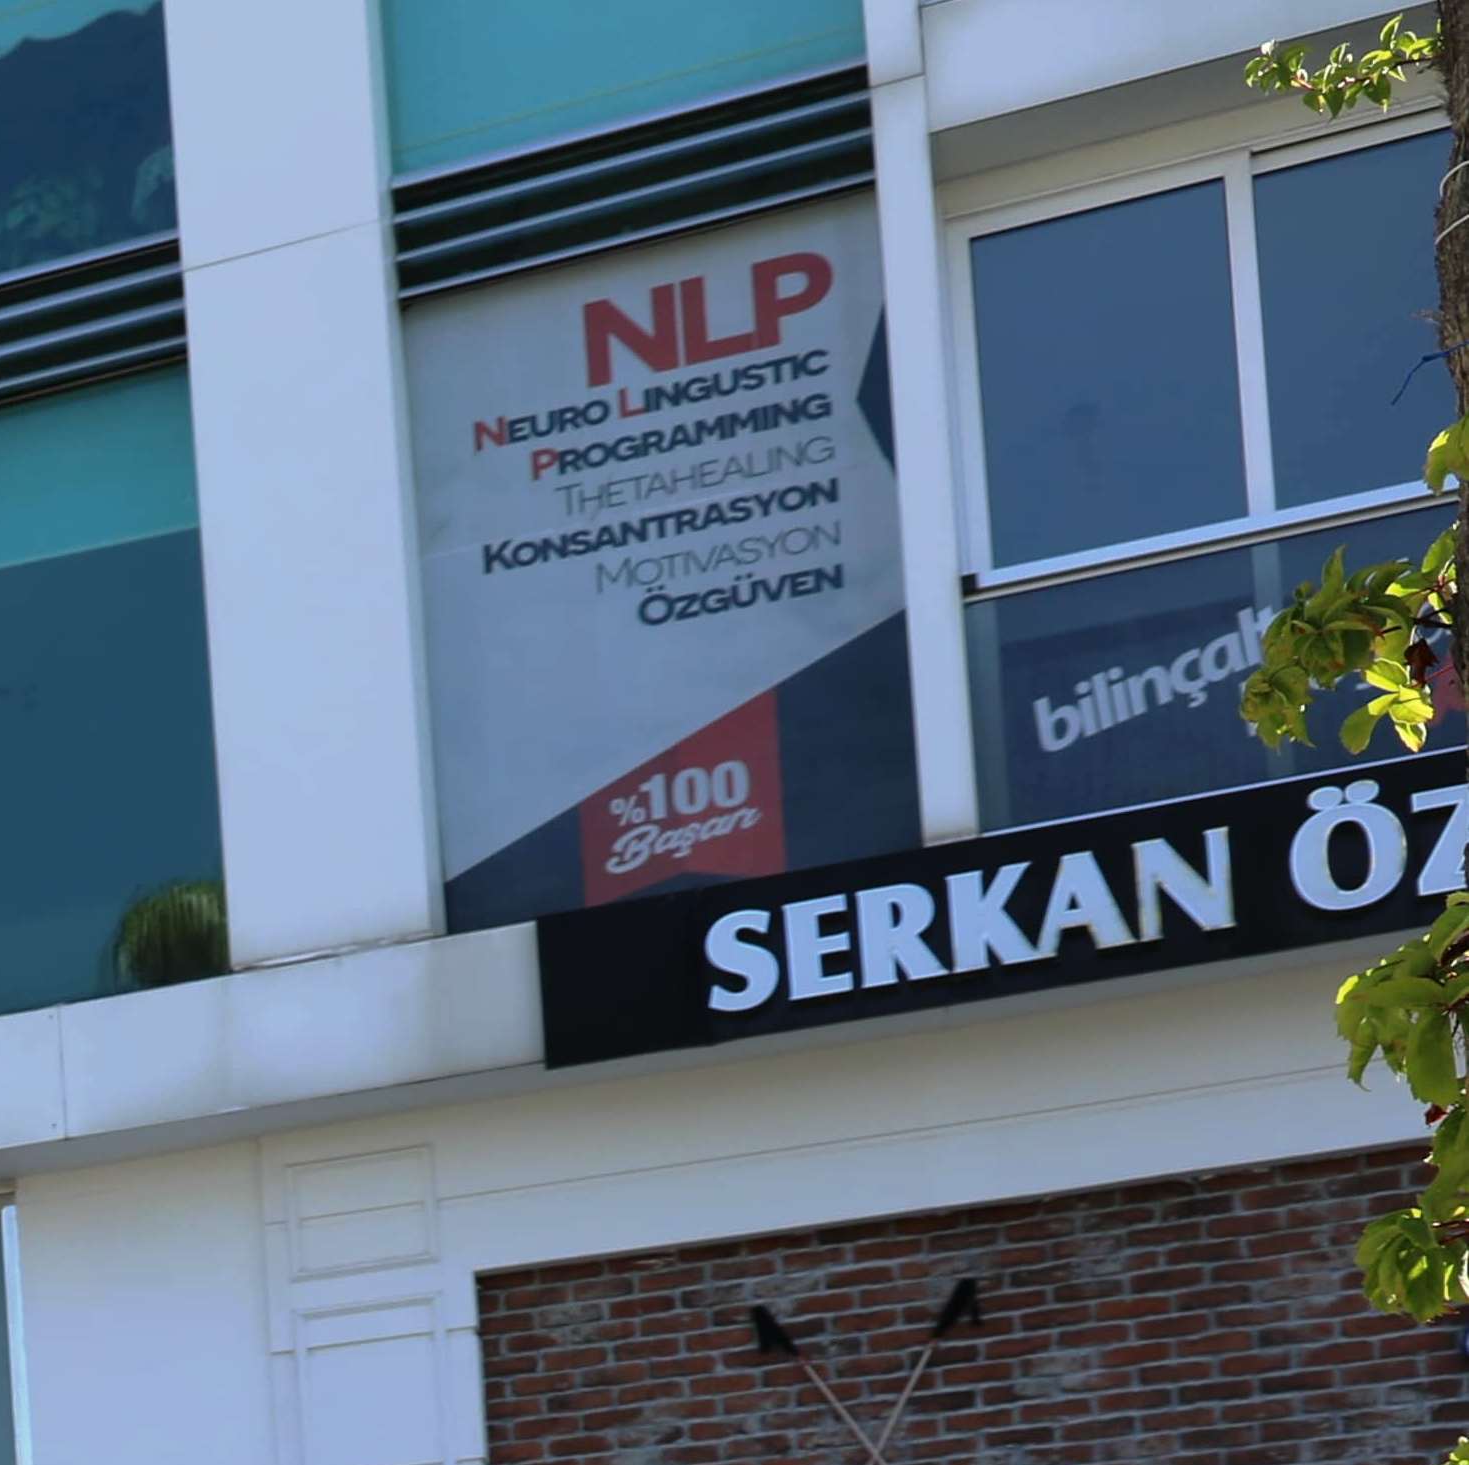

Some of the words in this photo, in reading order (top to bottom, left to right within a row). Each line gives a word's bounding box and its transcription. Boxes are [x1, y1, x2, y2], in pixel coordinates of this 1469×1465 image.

[583, 251, 834, 388] NLP
[474, 399, 610, 452] NEURO
[618, 349, 830, 419] LINGUSTIC
[531, 393, 832, 481] PROGRAMMING
[554, 436, 836, 516] THETAHEALING
[481, 477, 840, 575] KONSANTRASYON
[595, 520, 842, 595] MOTIVASYON
[638, 563, 845, 627] ÖZGÜVEN
[609, 759, 750, 827] %100
[701, 825, 1238, 1013] SERKAN
[1289, 778, 1469, 911] ÖZ
